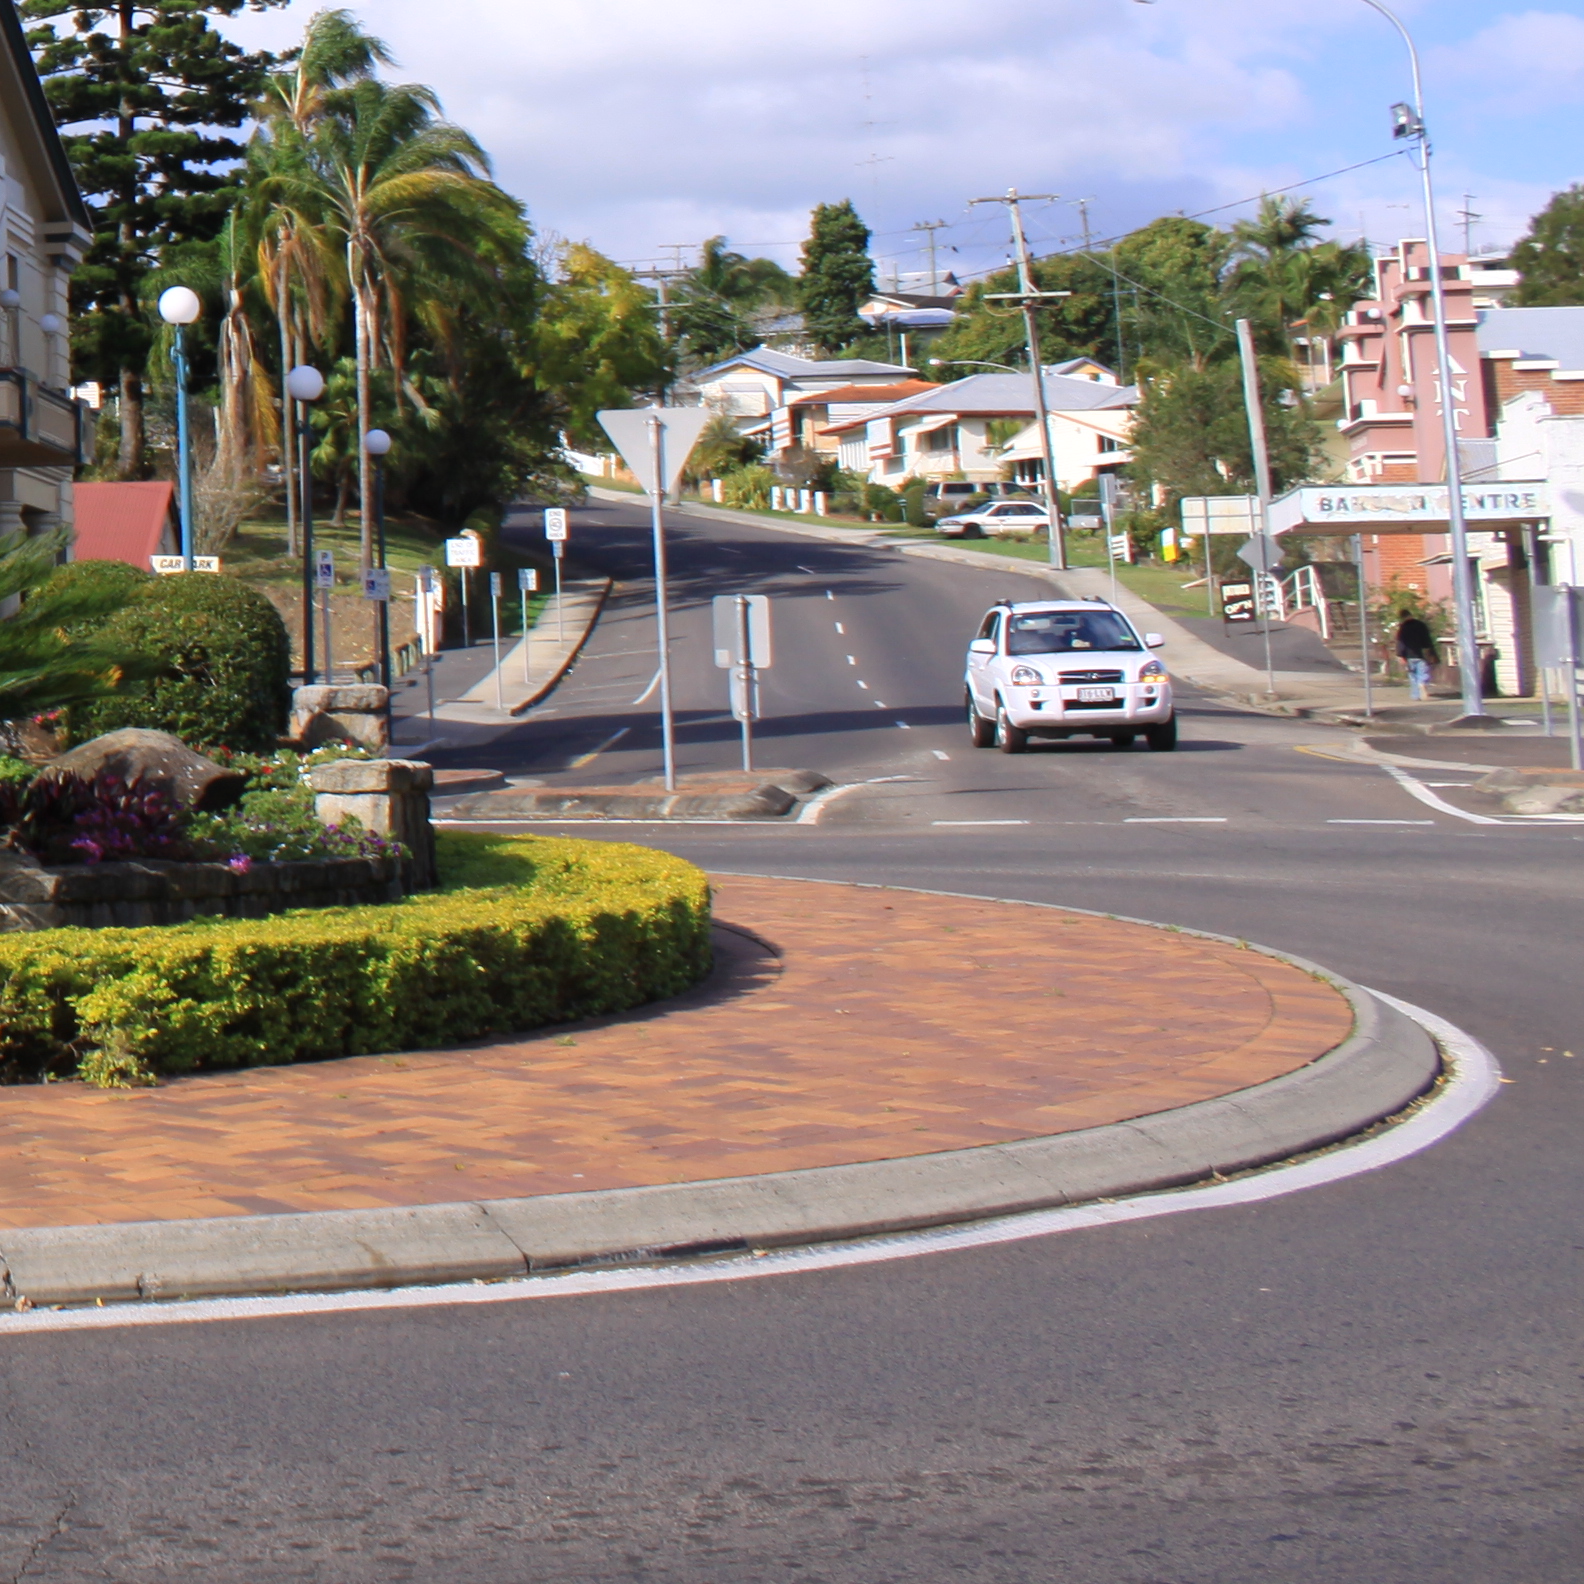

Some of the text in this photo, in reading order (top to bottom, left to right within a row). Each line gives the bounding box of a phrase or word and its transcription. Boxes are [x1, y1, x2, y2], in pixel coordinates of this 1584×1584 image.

[1461, 493, 1537, 510] ENTRE
[160, 559, 213, 569] CAR ARK
